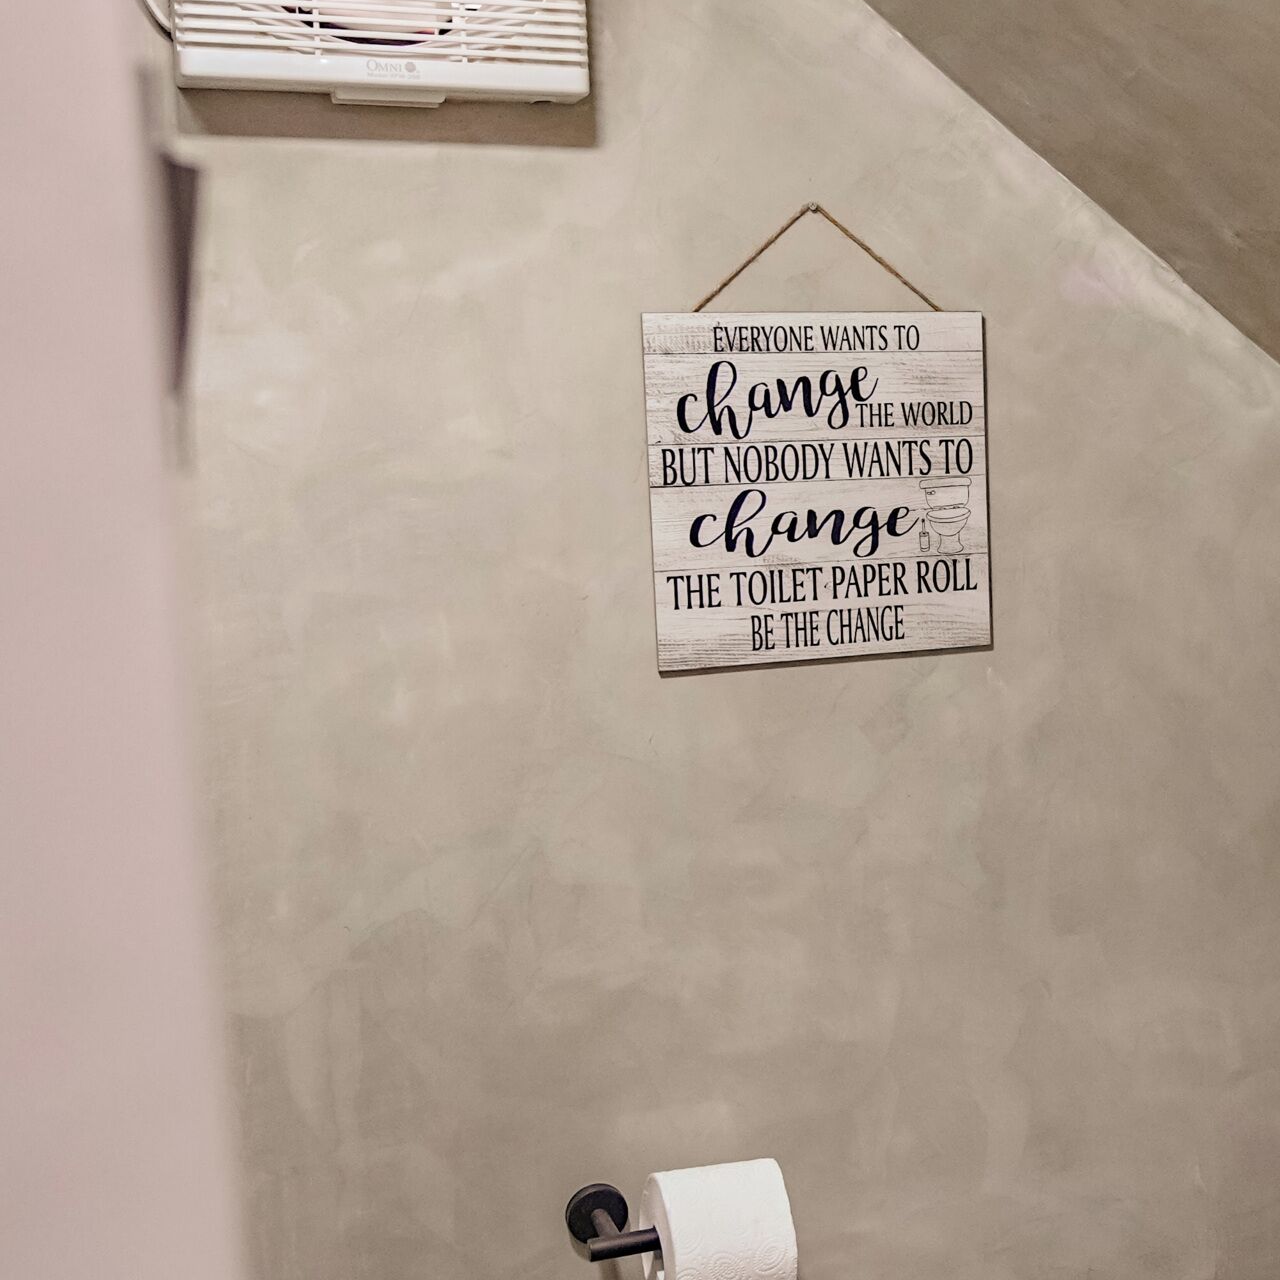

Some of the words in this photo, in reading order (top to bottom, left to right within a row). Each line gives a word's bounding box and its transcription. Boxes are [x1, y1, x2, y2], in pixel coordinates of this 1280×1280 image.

[713, 325, 814, 352] EVERYONE
[820, 324, 888, 351] WANTS
[894, 324, 920, 350] TO
[676, 360, 879, 440] change
[855, 402, 894, 428] THE
[901, 400, 973, 427] WORLD
[661, 447, 715, 486] BUT
[724, 442, 835, 484] NOBODY
[842, 439, 932, 478] WANTS
[939, 438, 973, 475] TO
[689, 489, 920, 558] change
[667, 573, 722, 610] THE
[730, 567, 823, 607] TOILET
[832, 561, 908, 599] PAPER
[916, 558, 978, 594] ROLL
[750, 614, 775, 651] BE
[780, 610, 820, 647] THE
[826, 605, 905, 646] CHANGE
